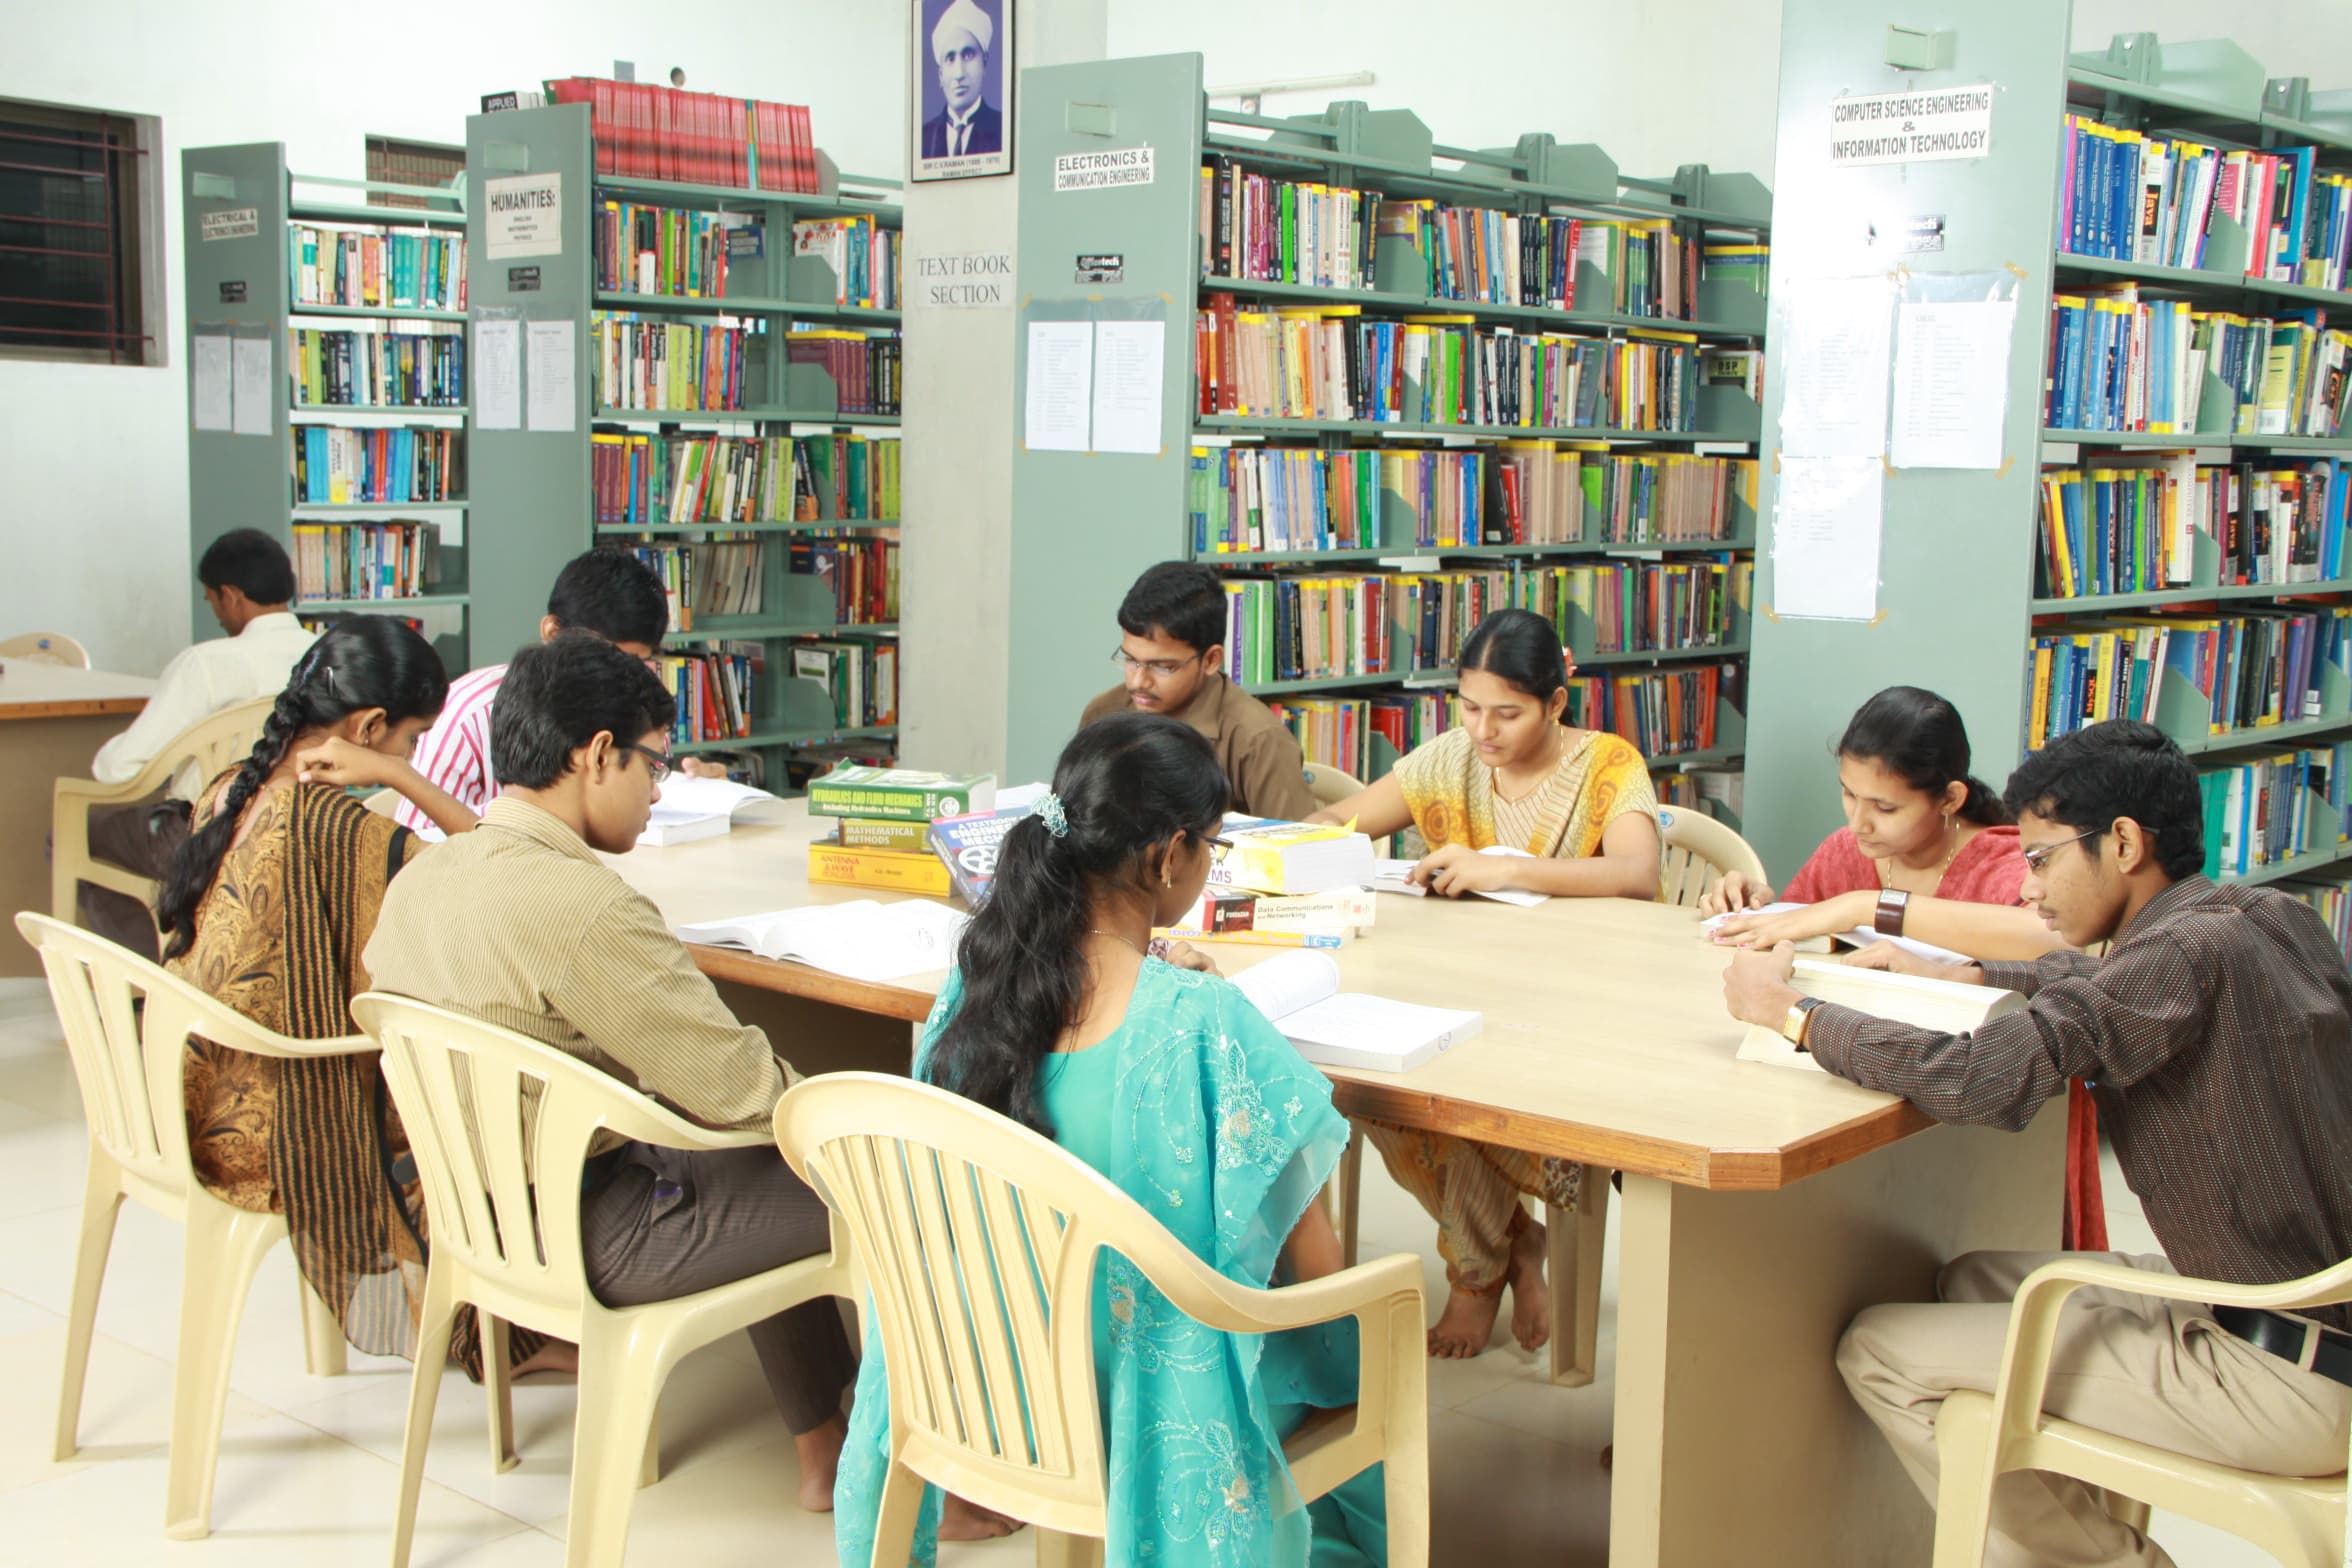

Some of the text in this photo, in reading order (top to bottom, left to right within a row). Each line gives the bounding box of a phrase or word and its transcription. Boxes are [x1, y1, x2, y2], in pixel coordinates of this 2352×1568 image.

[488, 95, 515, 110] APPLIED
[1834, 91, 1989, 123] COMPUTER SCIENCE ENGINEERING
[1902, 120, 1916, 132] &
[1832, 129, 1986, 160] INFORMATION TECHNOLOGY
[1058, 150, 1150, 172] ELECTRONICS &
[1058, 167, 1150, 189] COMMUNICATION ENGINEERING
[491, 189, 556, 213] HUMANITIES:
[2144, 192, 2160, 226] Java
[918, 255, 1011, 277] TEXT BOOK
[930, 284, 1001, 304] SECTION
[2086, 677, 2097, 713] MySQL
[847, 826, 915, 837] MATHEMATICAL
[847, 835, 891, 845] METHODS
[821, 855, 860, 866] ANTENNA
[1257, 905, 1274, 913] Data
[1276, 904, 1333, 913] Communications
[1267, 911, 1306, 920] Networking
